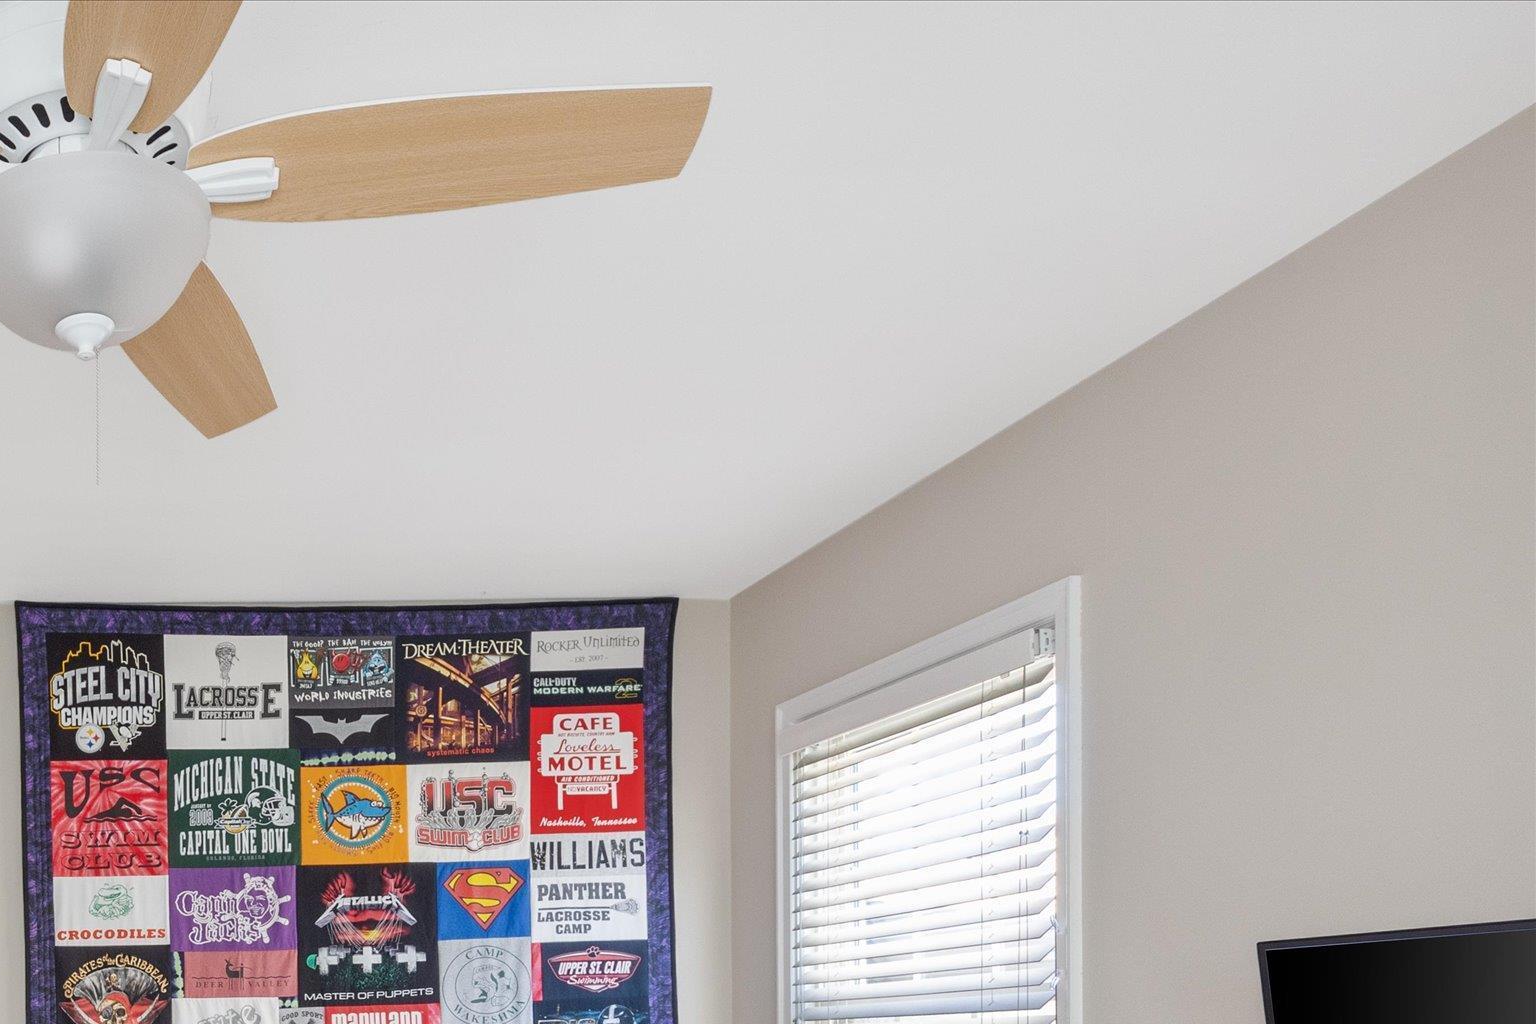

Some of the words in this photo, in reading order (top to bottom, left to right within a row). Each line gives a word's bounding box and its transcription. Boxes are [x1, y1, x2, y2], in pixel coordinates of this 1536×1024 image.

[458, 638, 529, 656] THEATER
[537, 639, 583, 654] ROCKER
[53, 665, 114, 711] STEEL
[117, 666, 161, 708] CITY
[294, 690, 330, 702] WORLD
[333, 687, 392, 700] INDUSTRIES
[533, 687, 584, 695] MODERN
[587, 684, 641, 693] WARFARE
[172, 682, 283, 720] LACROSSE
[61, 705, 155, 727] CHAMPIONS
[201, 711, 222, 719] UPPER
[233, 711, 254, 719] CLAIR
[559, 717, 613, 731] CAFE
[427, 747, 470, 757] systematic
[554, 738, 620, 754] Loveless
[548, 756, 627, 771] MOTEL
[173, 756, 243, 812] MICHIGAN
[251, 757, 295, 806] STATE
[59, 767, 160, 818] USC
[421, 776, 517, 820] USC
[189, 809, 214, 826] 2009
[539, 816, 586, 827] Nashville,
[591, 816, 638, 826] Tennessee
[61, 830, 161, 849] SWIM
[179, 830, 230, 856] CAPITAL
[234, 829, 257, 854] ONE
[261, 828, 292, 853] BOWL
[417, 827, 470, 847] SWIM
[482, 824, 522, 845] CLUB
[61, 853, 162, 870] CLUB
[530, 838, 645, 870] WILLIAMS
[537, 882, 626, 901] PANTHER
[537, 910, 610, 922] LACROSSE
[57, 928, 166, 940] CROCODILES
[555, 923, 592, 934] CAMP
[465, 947, 504, 960] CAMP
[558, 961, 588, 975] UPPER
[588, 961, 603, 975] ST.
[604, 960, 632, 974] CLAIR
[63, 957, 104, 998] PIRATES
[115, 954, 169, 993] CARIBBEAN
[567, 975, 620, 988] Swimming
[248, 980, 288, 988] VALLEY
[304, 991, 355, 1001] MASTER
[357, 991, 374, 1000] OF
[376, 987, 434, 999] PUPPETS
[301, 1010, 324, 1020] SPORT
